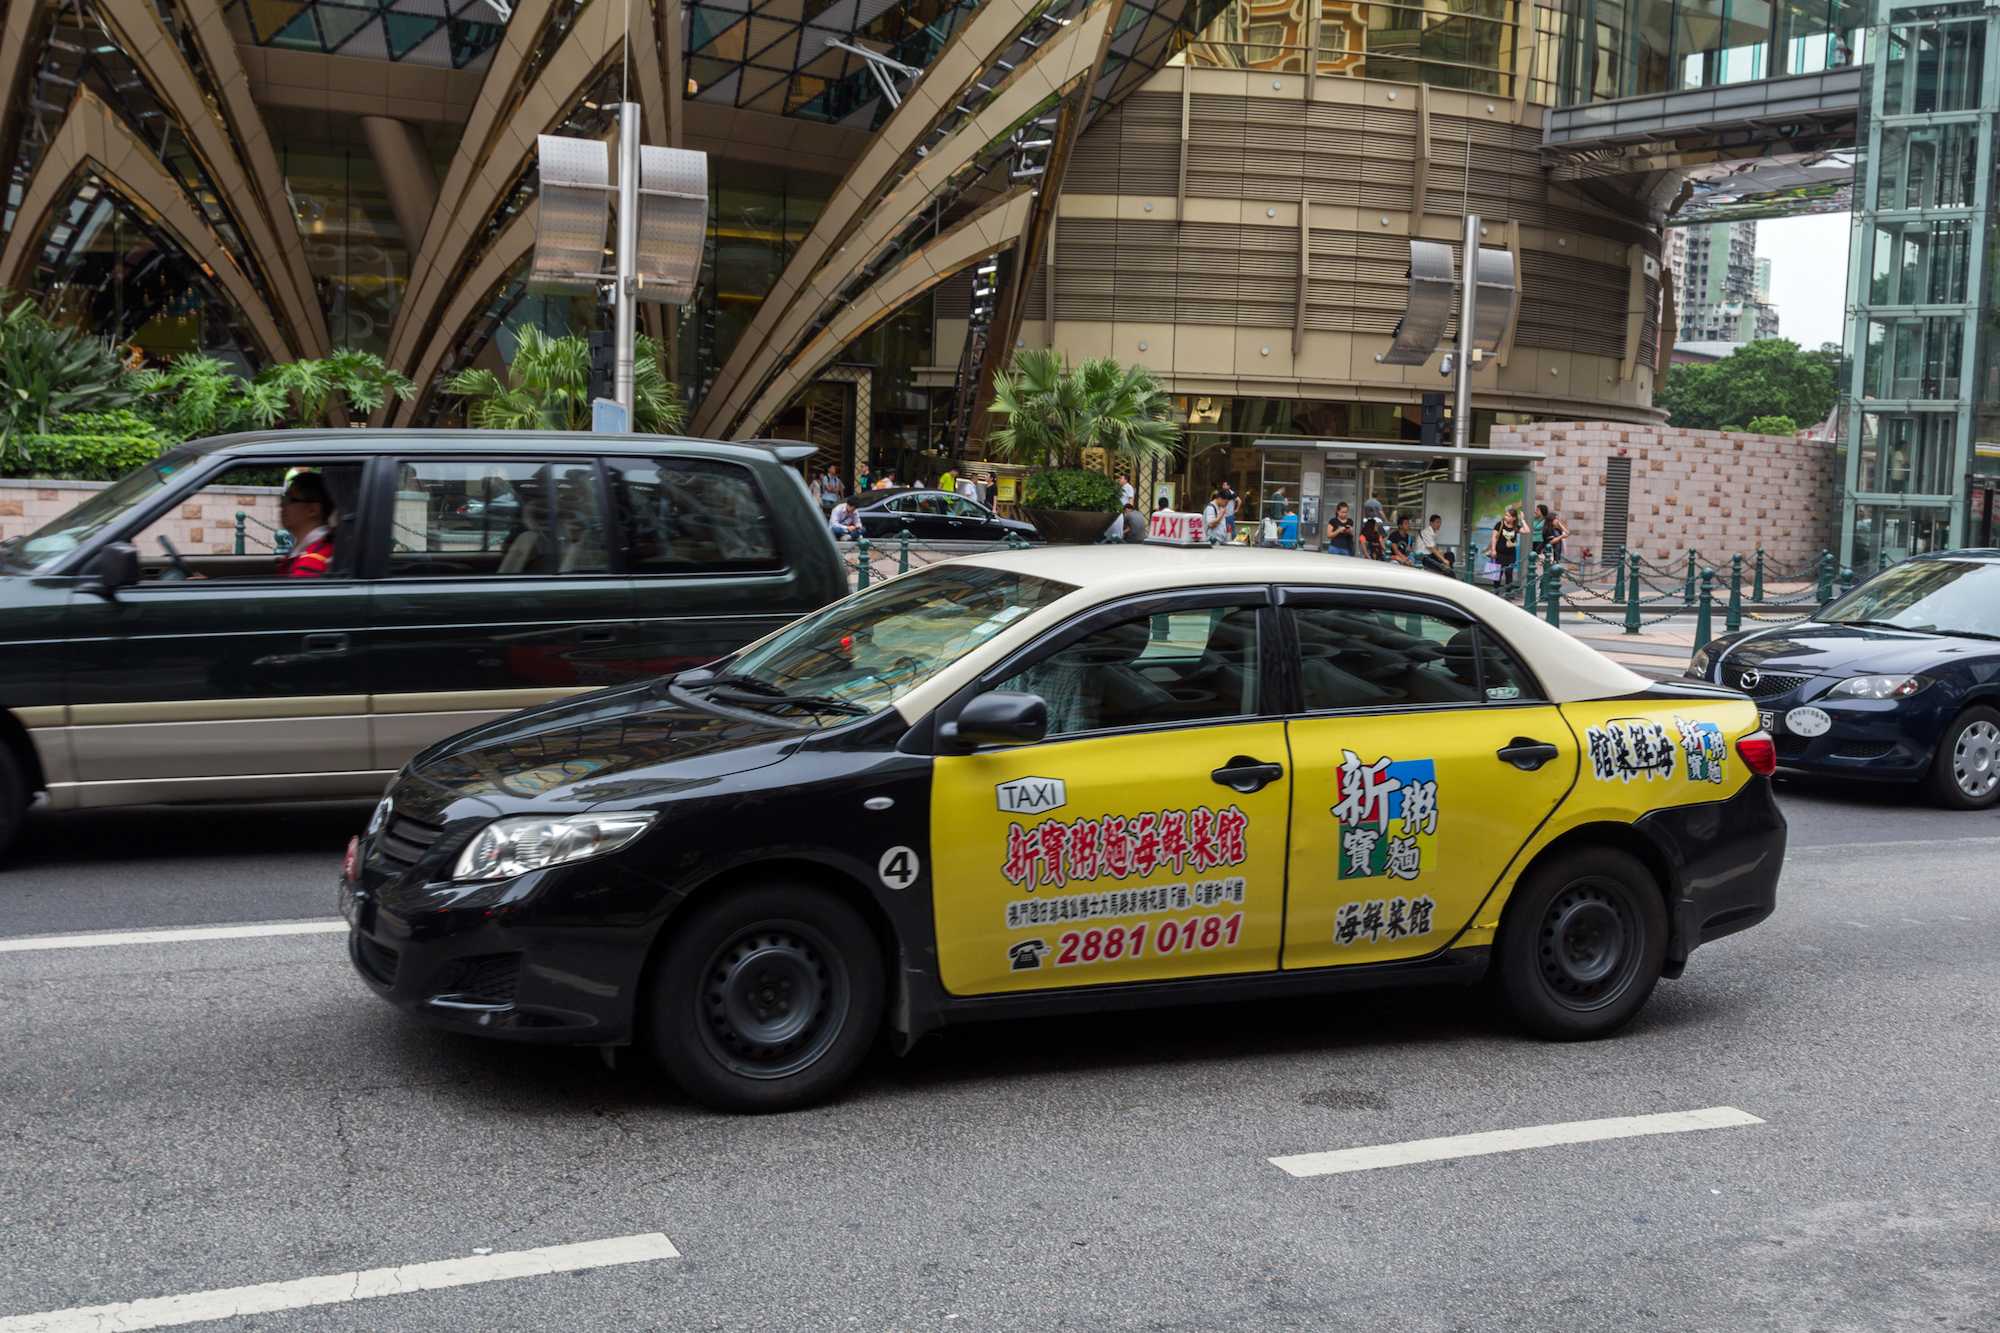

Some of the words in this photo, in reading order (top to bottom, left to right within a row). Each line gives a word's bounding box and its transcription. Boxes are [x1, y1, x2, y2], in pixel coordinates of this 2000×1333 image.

[1151, 516, 1184, 539] TAXI
[1188, 518, 1203, 541] 的士
[1003, 783, 1057, 808] TAXI
[1004, 806, 1246, 891] 新寶粥麵海鮮菜館
[884, 851, 912, 883] 4
[1336, 897, 1434, 945] 海鮮菜館
[1058, 924, 1147, 966] 2881
[1157, 914, 1243, 957] 0181
